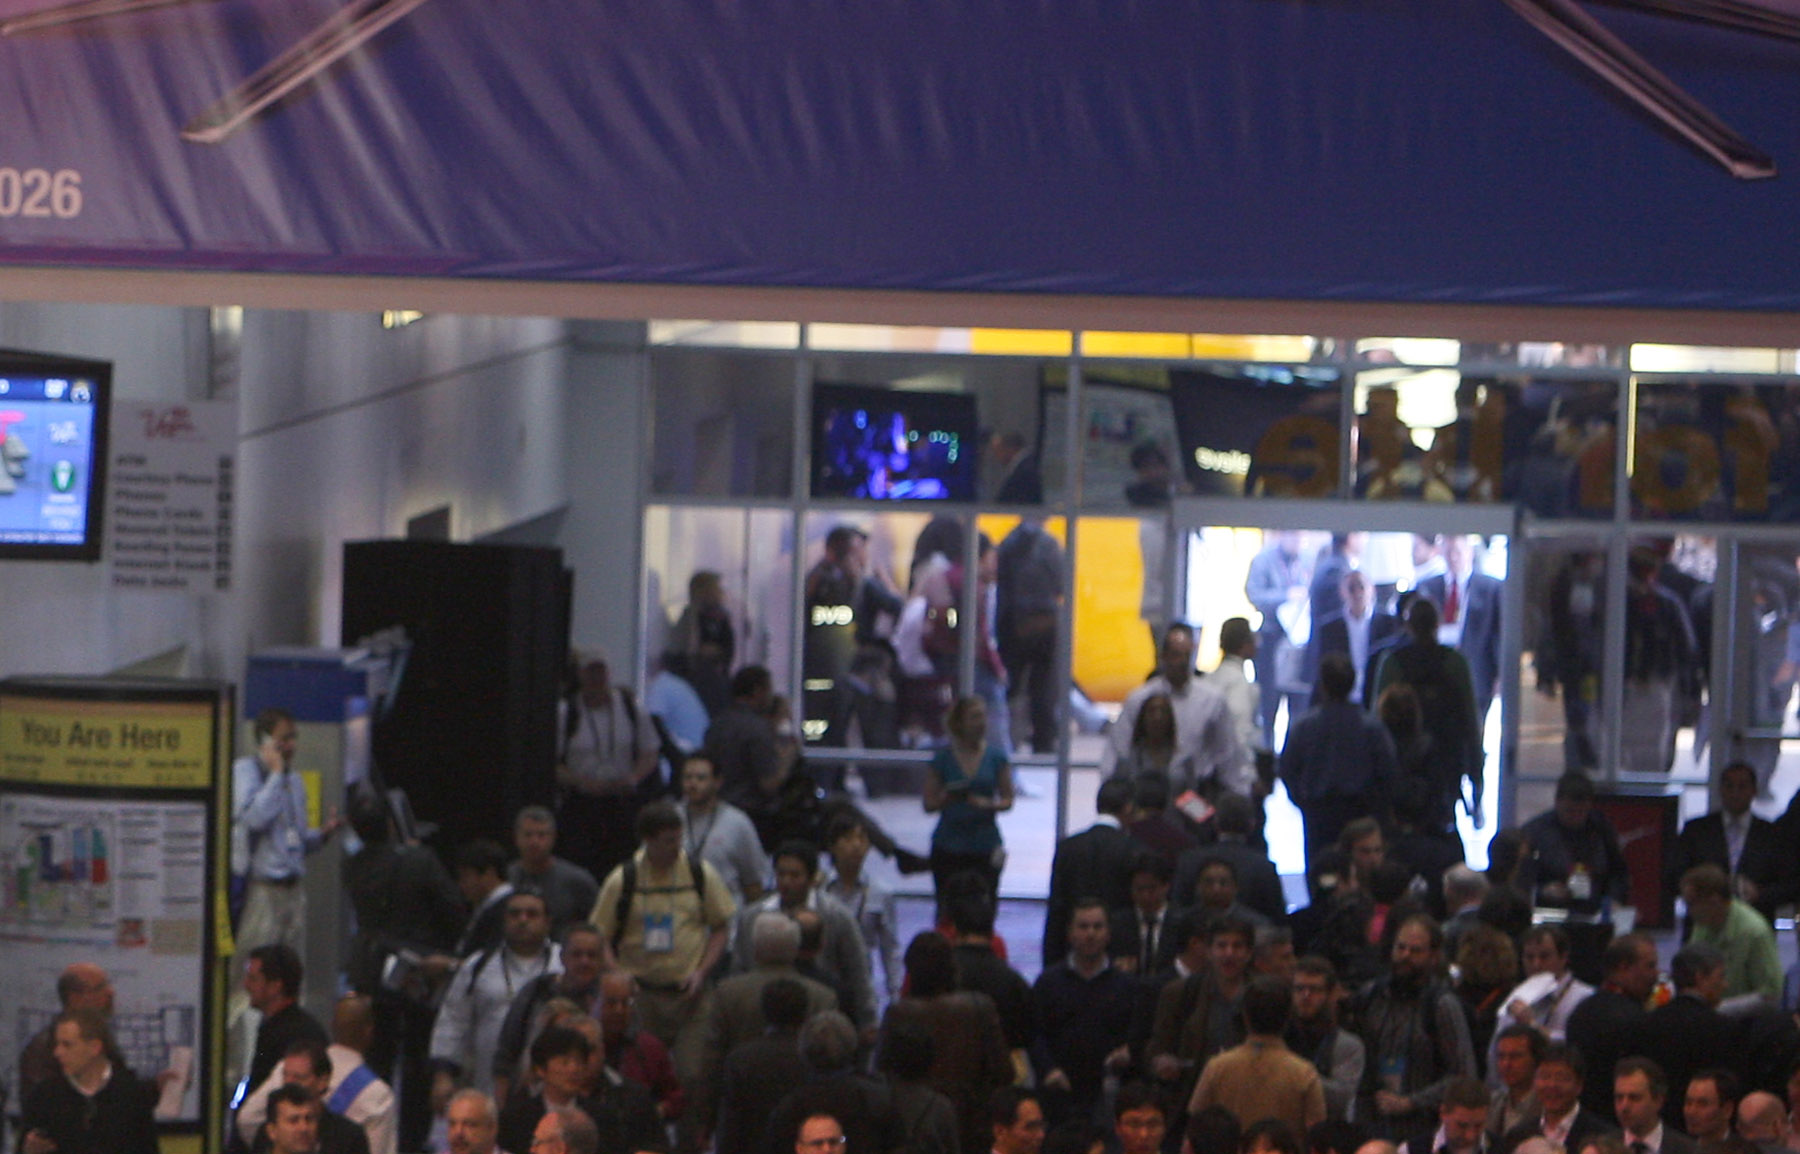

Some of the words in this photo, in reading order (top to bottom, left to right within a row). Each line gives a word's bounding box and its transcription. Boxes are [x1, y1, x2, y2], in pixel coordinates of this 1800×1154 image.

[21, 717, 61, 747] You
[68, 720, 112, 749] Are
[120, 722, 181, 751] Here
